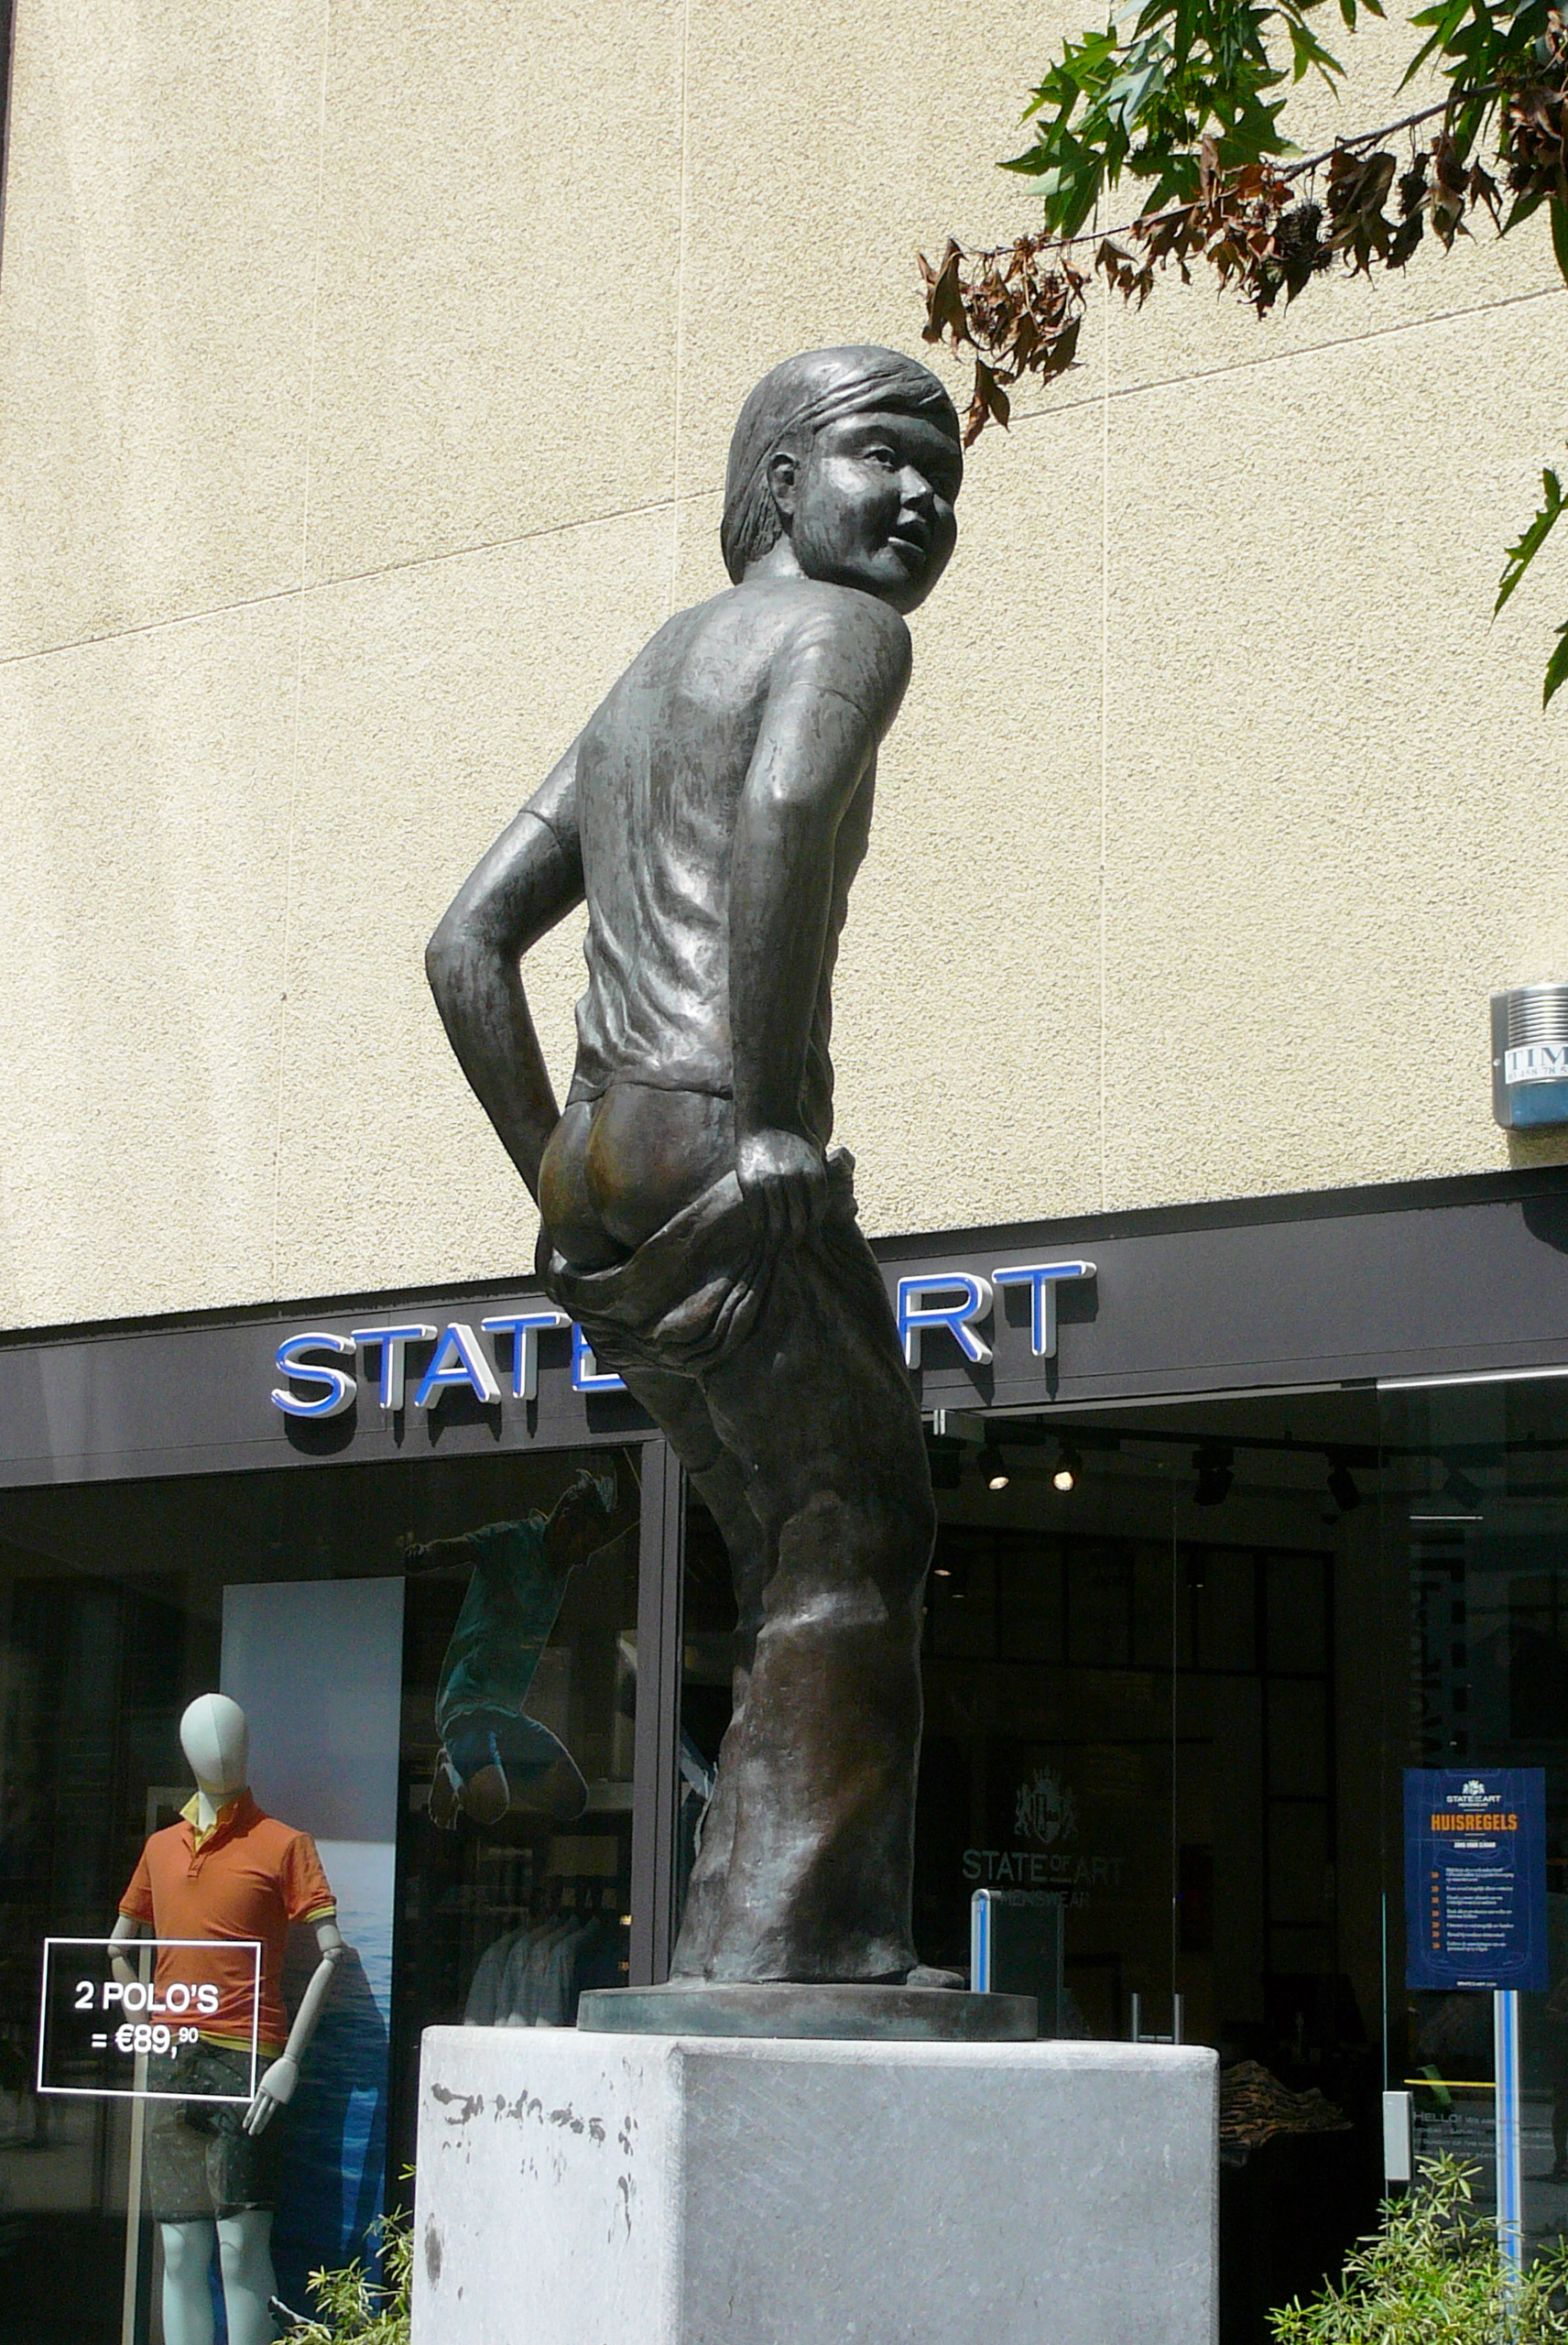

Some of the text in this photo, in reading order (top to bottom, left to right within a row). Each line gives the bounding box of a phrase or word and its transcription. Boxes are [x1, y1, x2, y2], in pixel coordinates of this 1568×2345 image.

[1431, 1814, 1518, 1831] HUISREGELS
[962, 1849, 1048, 1882] STATE
[74, 1980, 219, 2013] 2 POLO'S
